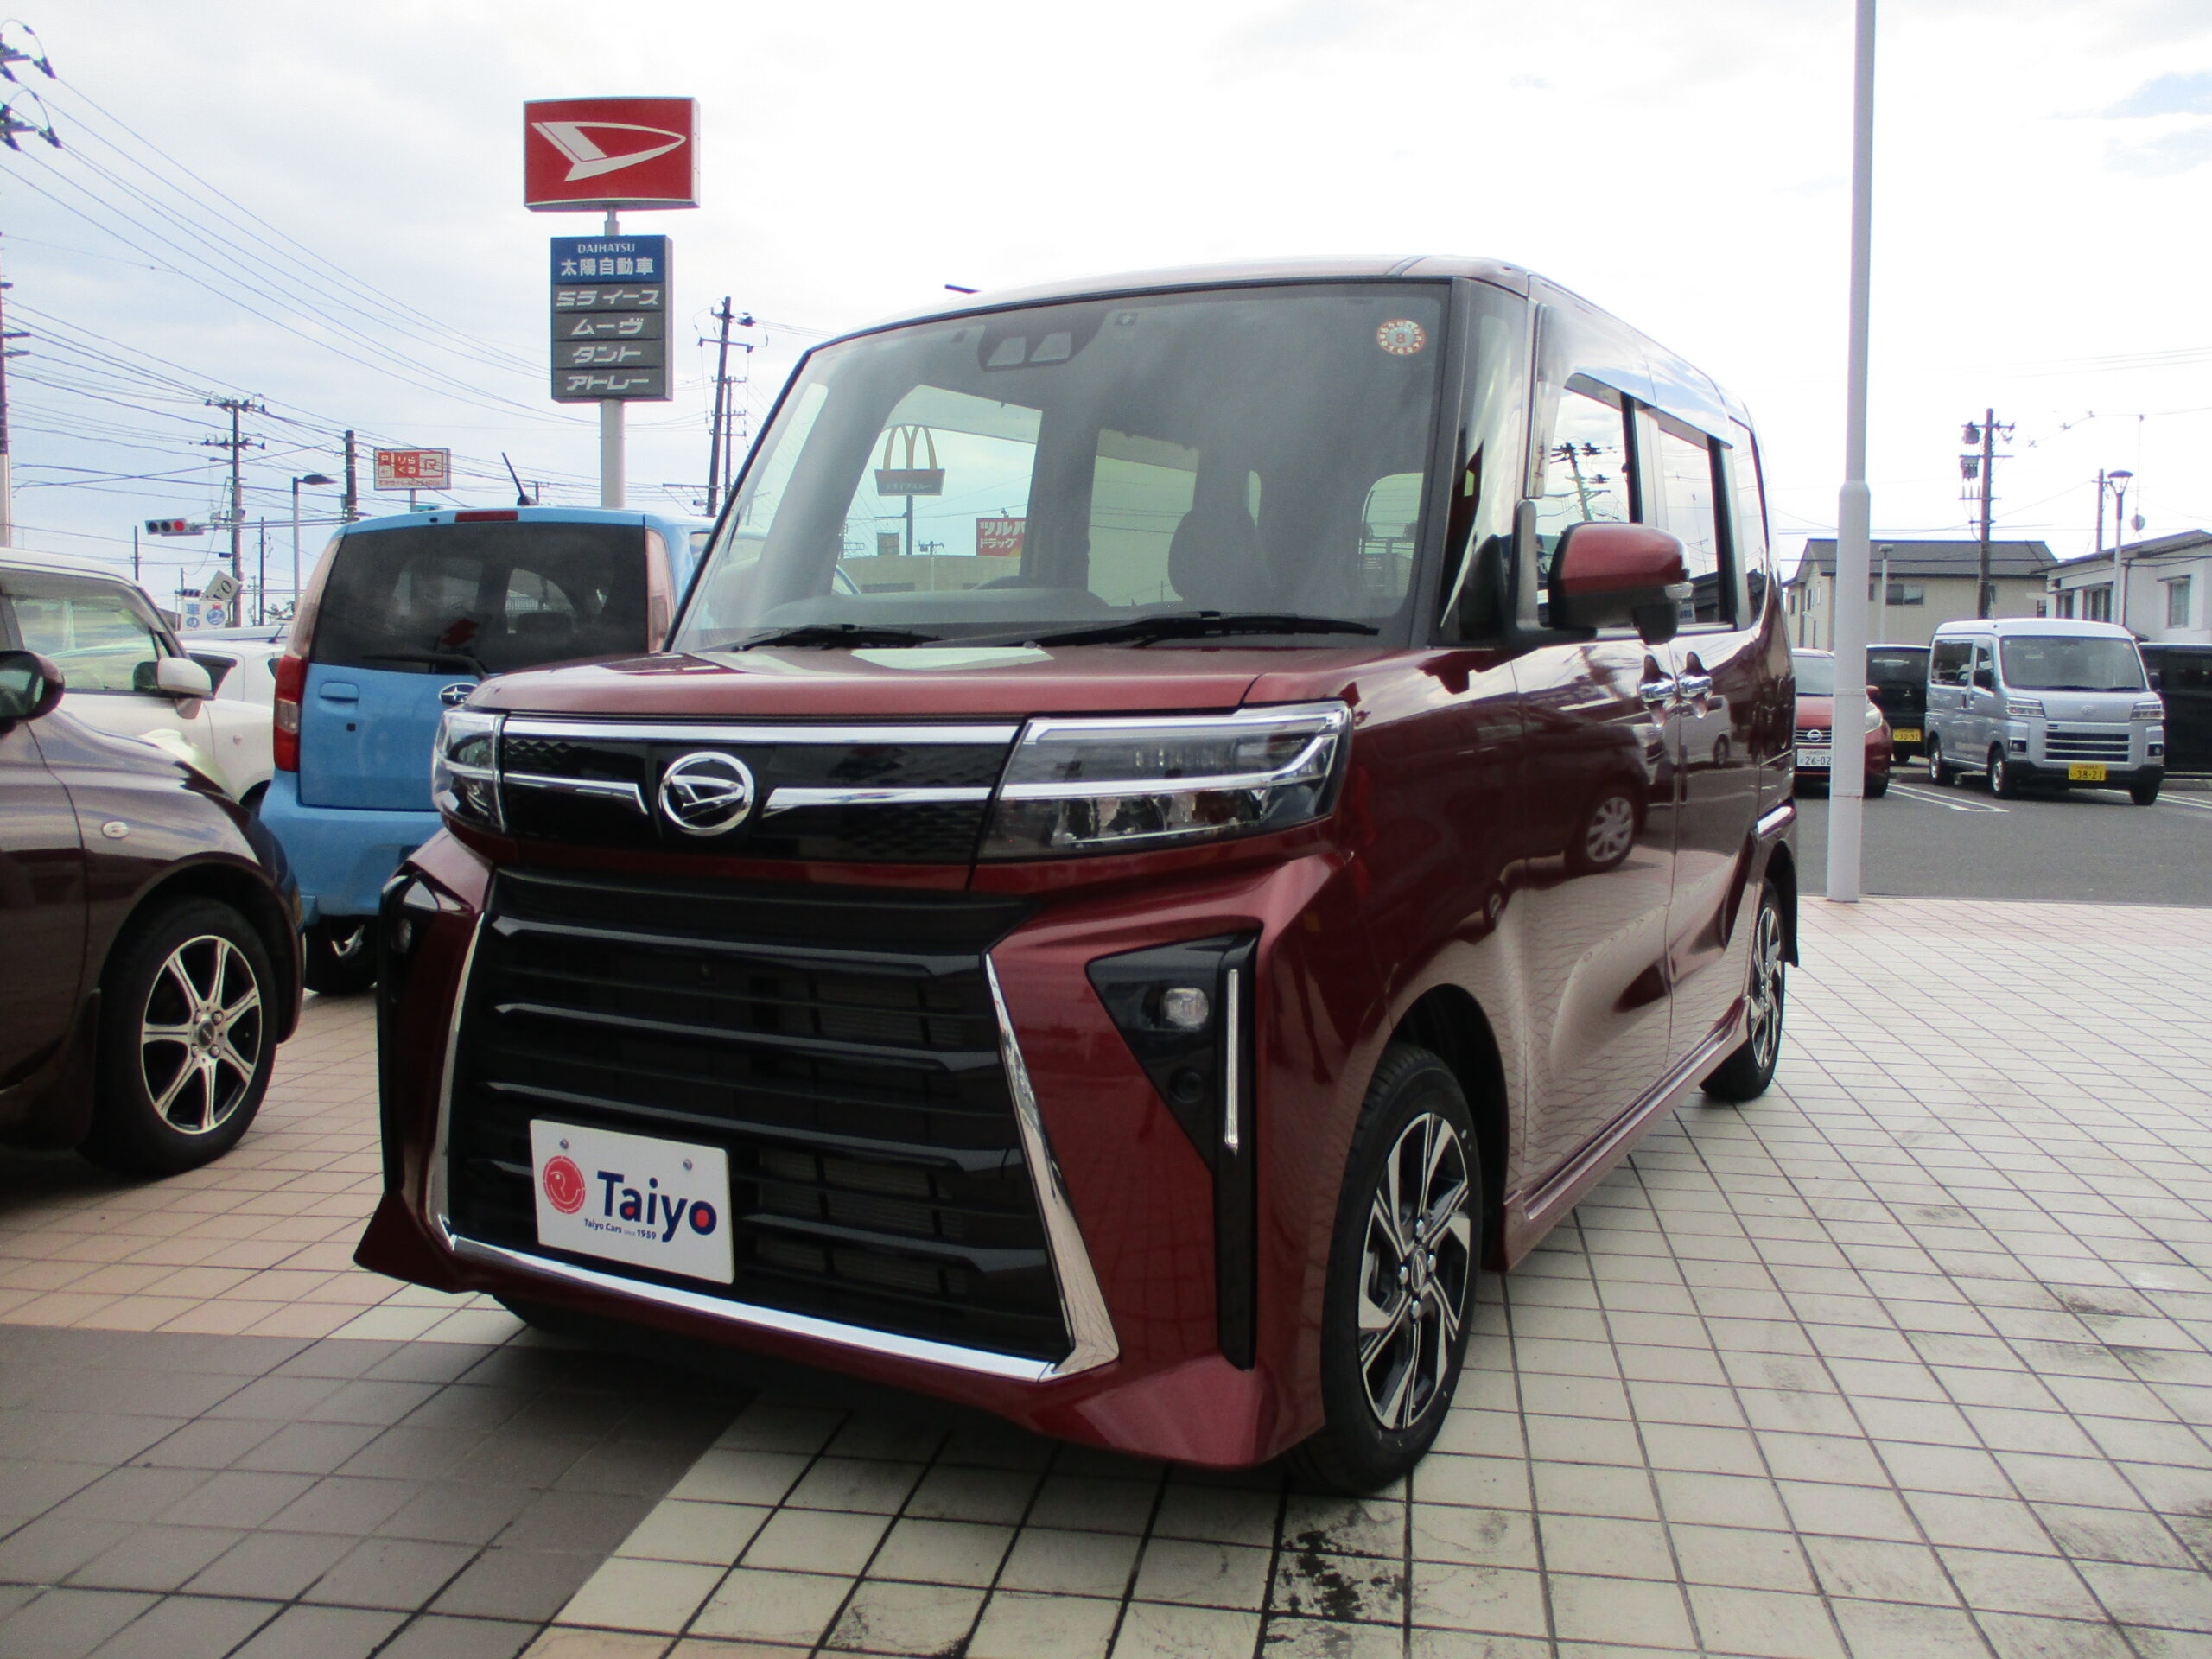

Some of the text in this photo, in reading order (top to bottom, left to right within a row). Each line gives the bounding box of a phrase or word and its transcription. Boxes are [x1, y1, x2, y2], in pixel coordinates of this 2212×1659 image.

[578, 243, 635, 254] DAIHATSU
[561, 257, 654, 276] 太陽自動車
[571, 317, 644, 335] ムーヴ
[573, 346, 642, 364] タント
[567, 375, 650, 391] アトレー
[596, 1170, 717, 1243] Taiyo
[584, 1218, 604, 1230] Taiyo
[606, 1222, 622, 1234] Cars
[637, 1229, 657, 1240] 1959
